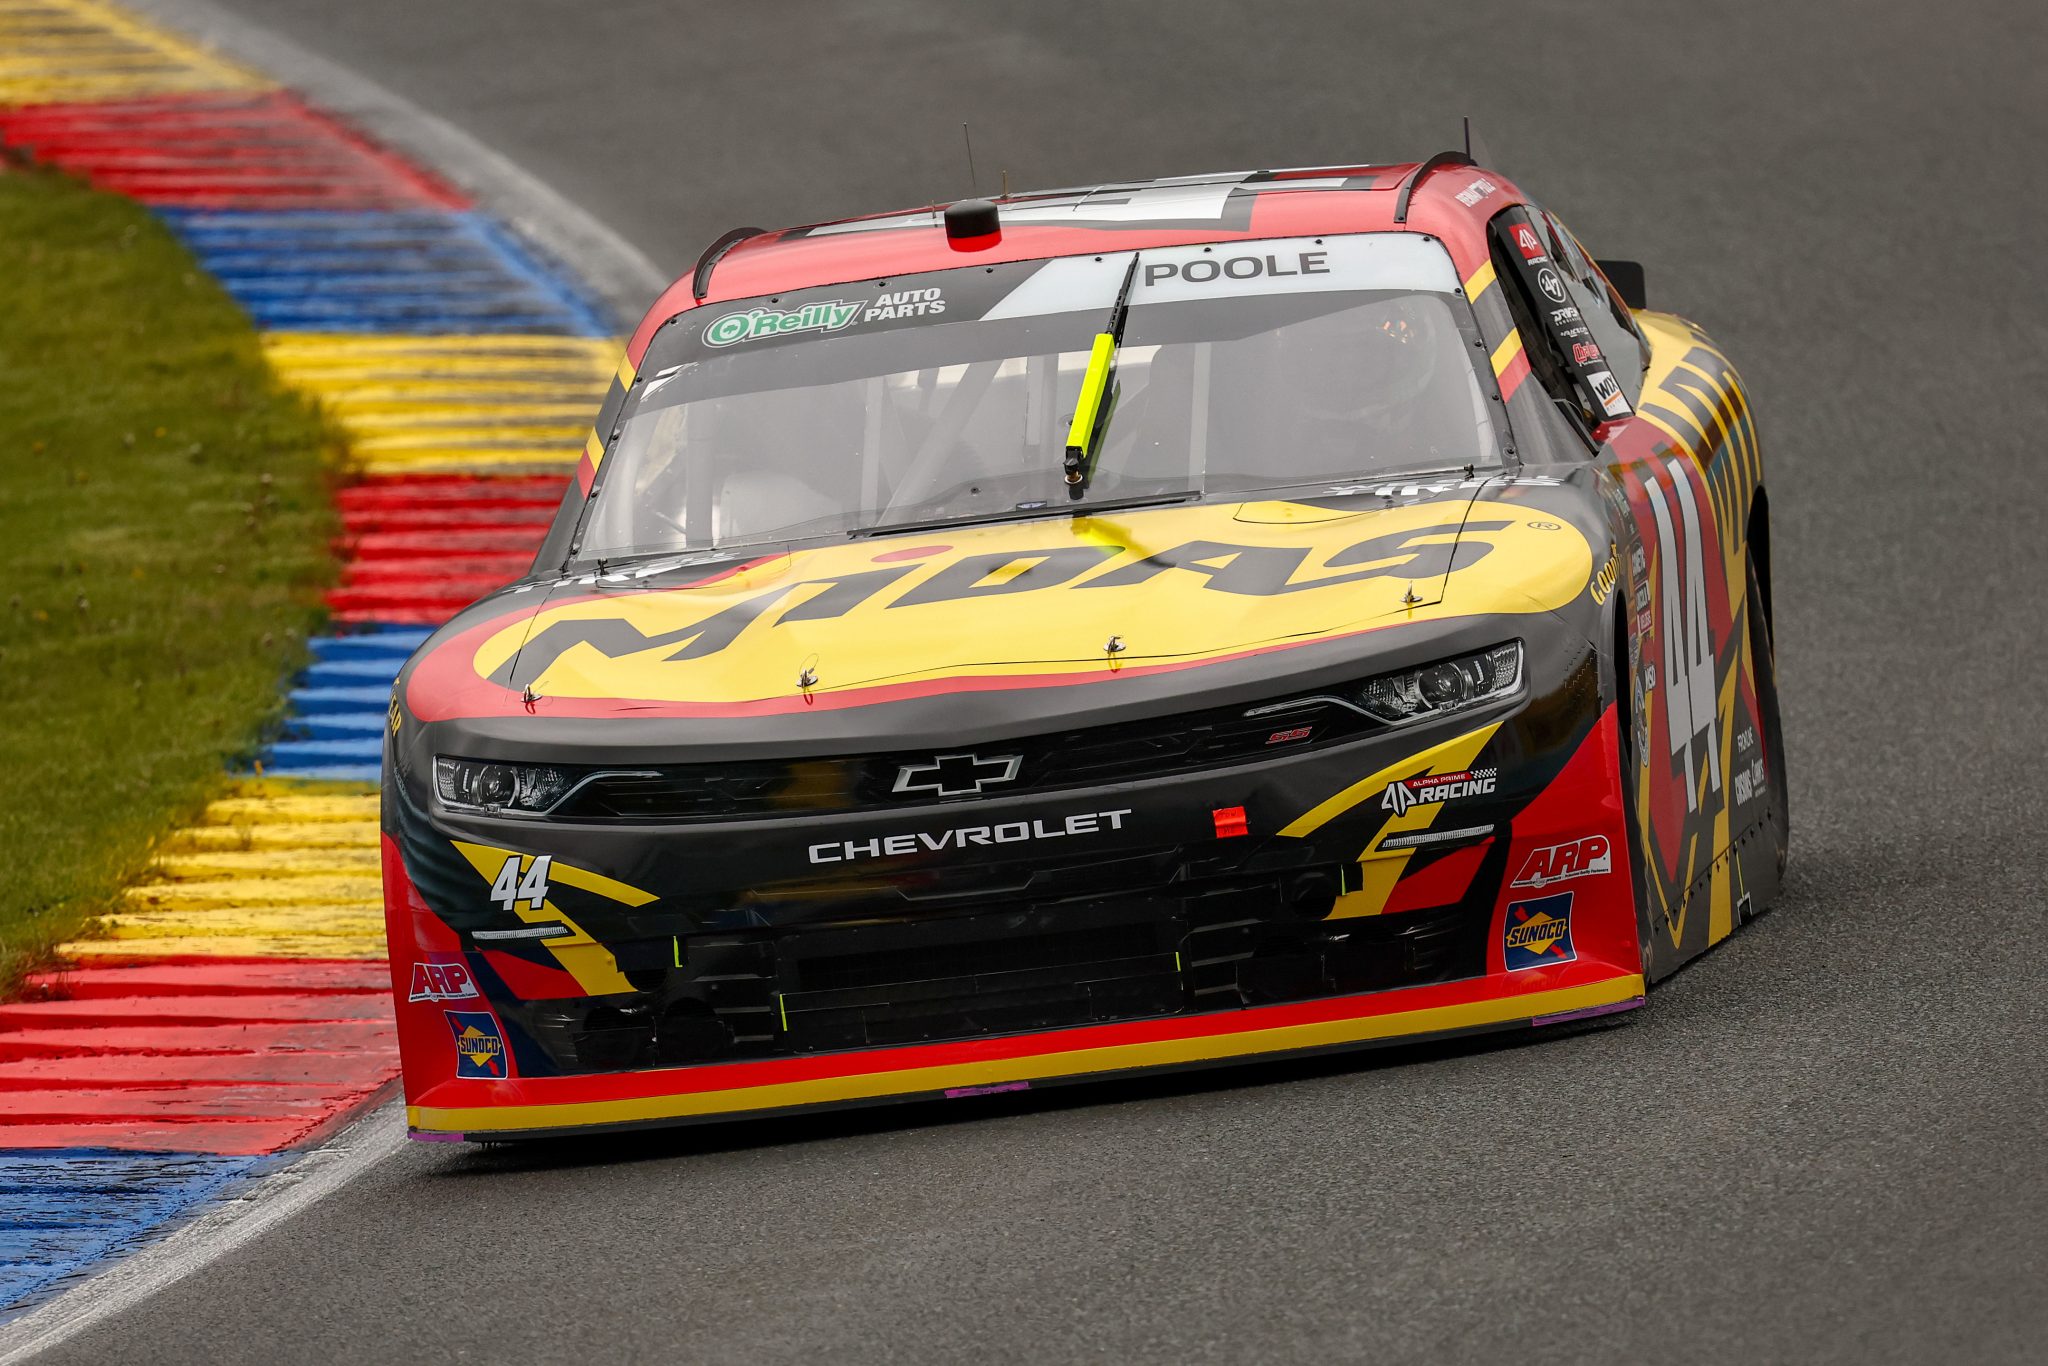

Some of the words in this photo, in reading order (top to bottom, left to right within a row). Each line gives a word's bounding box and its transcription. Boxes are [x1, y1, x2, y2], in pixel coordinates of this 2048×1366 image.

[1144, 250, 1331, 288] POOLE
[863, 300, 946, 322] PARTS
[873, 287, 942, 308] AUTO
[709, 300, 859, 334] O'Reilly
[1594, 375, 1619, 400] WIX
[1644, 458, 1721, 814] 44
[1412, 778, 1440, 787] ALPHA
[1440, 773, 1466, 783] PRIME
[1418, 777, 1497, 804] RACING
[808, 807, 1133, 865] CHEVROLET
[1514, 836, 1610, 880] ARP
[489, 854, 553, 911] 44
[1508, 920, 1565, 946] SUNOCO
[412, 963, 469, 995] ARP
[459, 1036, 499, 1054] SUNOCO
